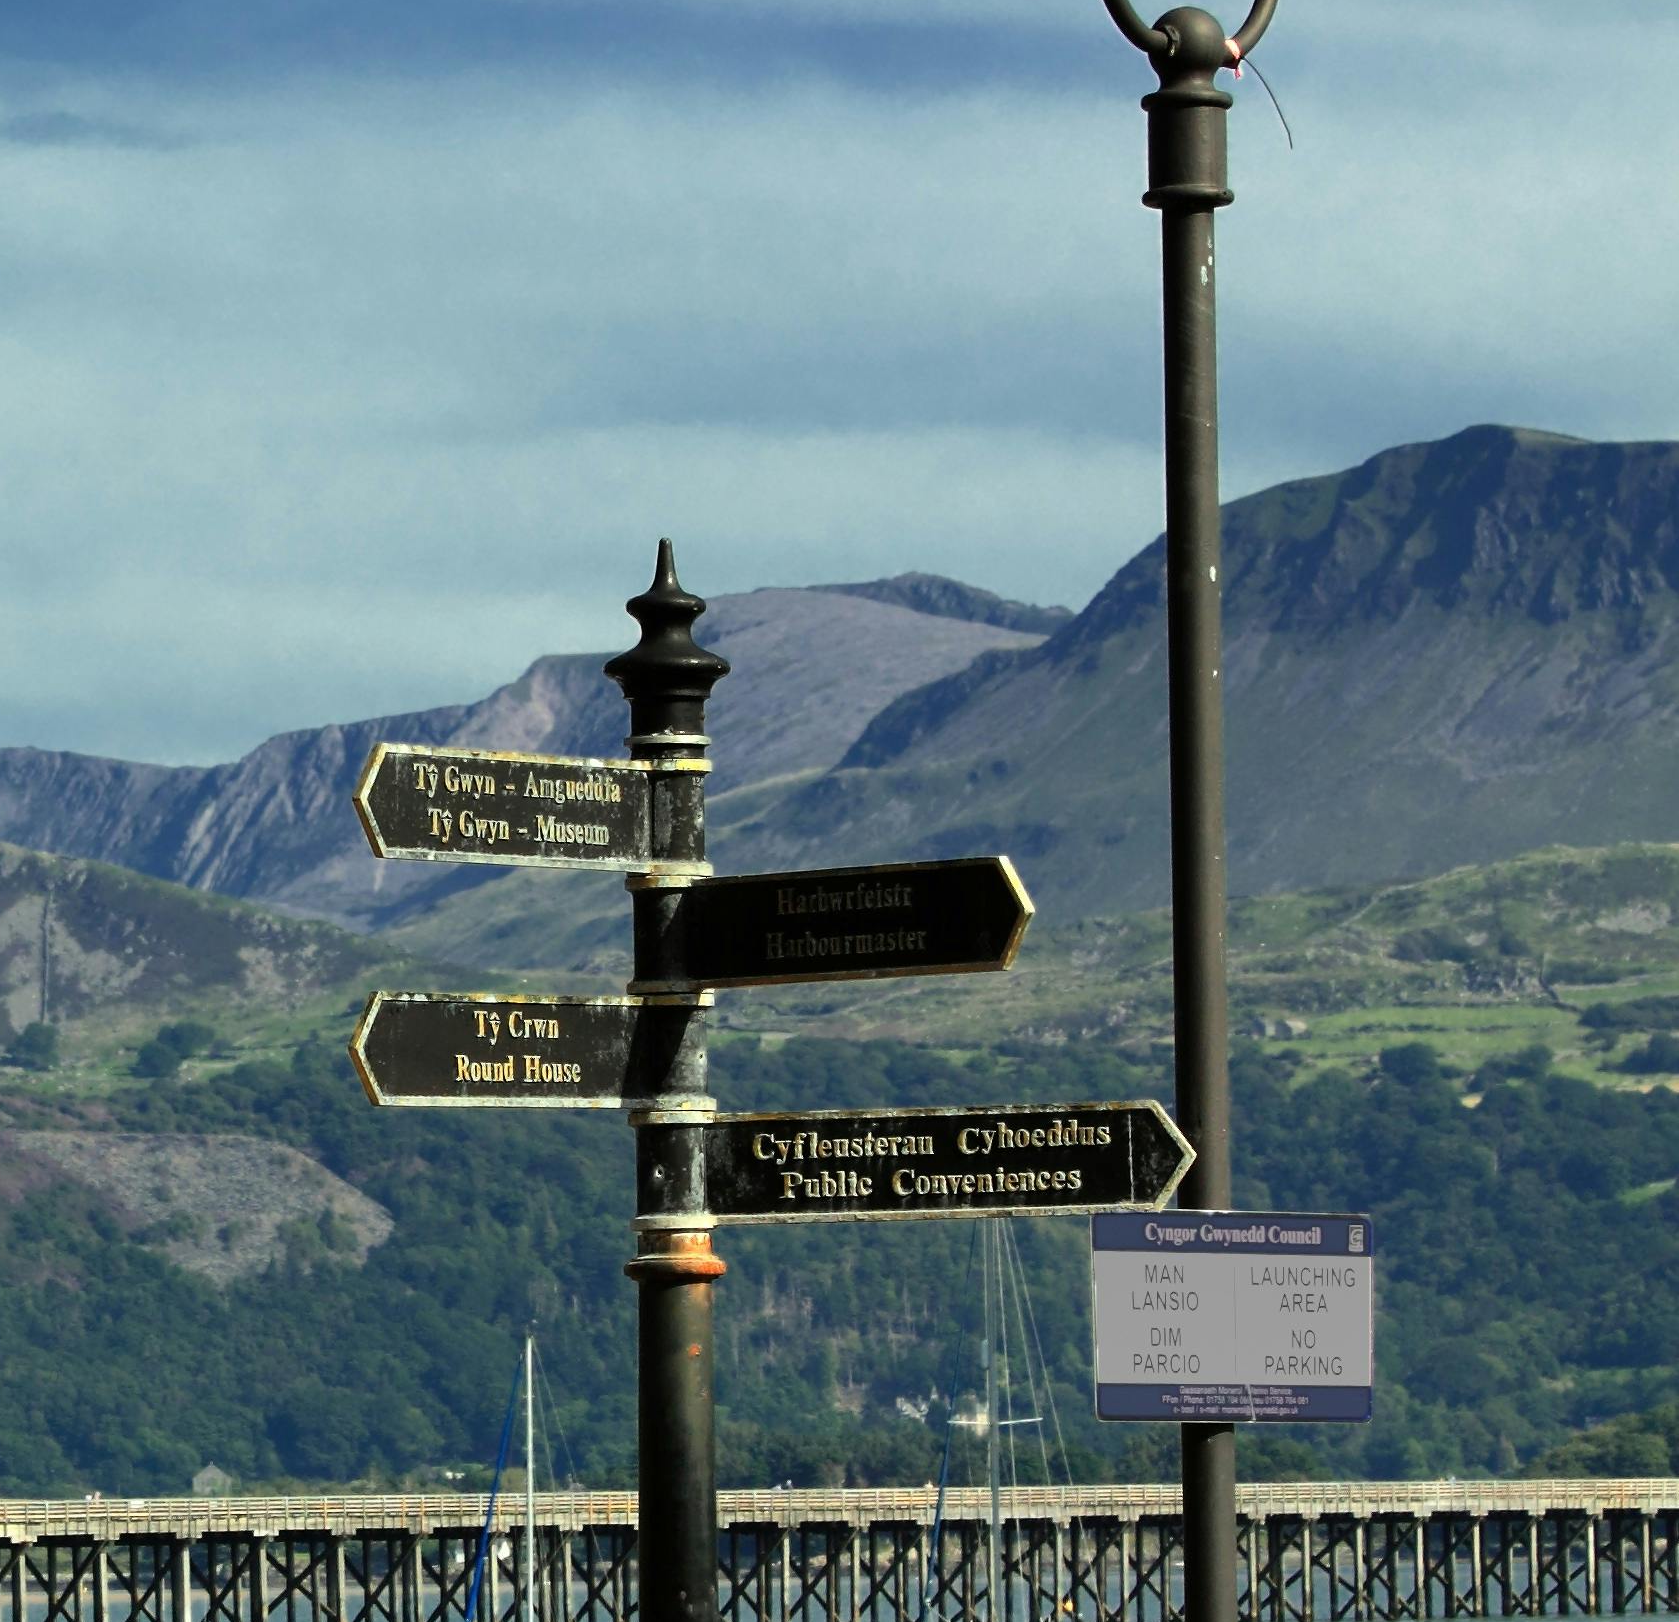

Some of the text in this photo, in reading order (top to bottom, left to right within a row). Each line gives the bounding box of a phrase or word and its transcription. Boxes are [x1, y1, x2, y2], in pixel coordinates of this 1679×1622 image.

[412, 762, 438, 798] Tŷ
[445, 764, 496, 797] Gwyn
[523, 771, 621, 804] Amgueddfa
[428, 807, 453, 843] Tŷ
[459, 810, 510, 844] Gwyn
[534, 814, 610, 846] Museum
[765, 928, 927, 960] Harbourmaster
[474, 1010, 560, 1045] Tŷ Crwn
[455, 1054, 581, 1083] Round House
[752, 1119, 1112, 1165] Cyfleusterau Cyhoeddus
[779, 1168, 1083, 1200] Public Conveniences
[1144, 1223, 1322, 1246] Cyngor Gwynedd Council
[1144, 1265, 1185, 1284] MAN
[1250, 1267, 1356, 1287] LAUNCHING
[1132, 1291, 1200, 1312] LANSIO
[1279, 1293, 1328, 1313] AREA
[1150, 1328, 1182, 1347] DIM
[1291, 1330, 1316, 1349] NO
[1133, 1354, 1201, 1374] PARCIO
[1265, 1356, 1343, 1376] PARKING
